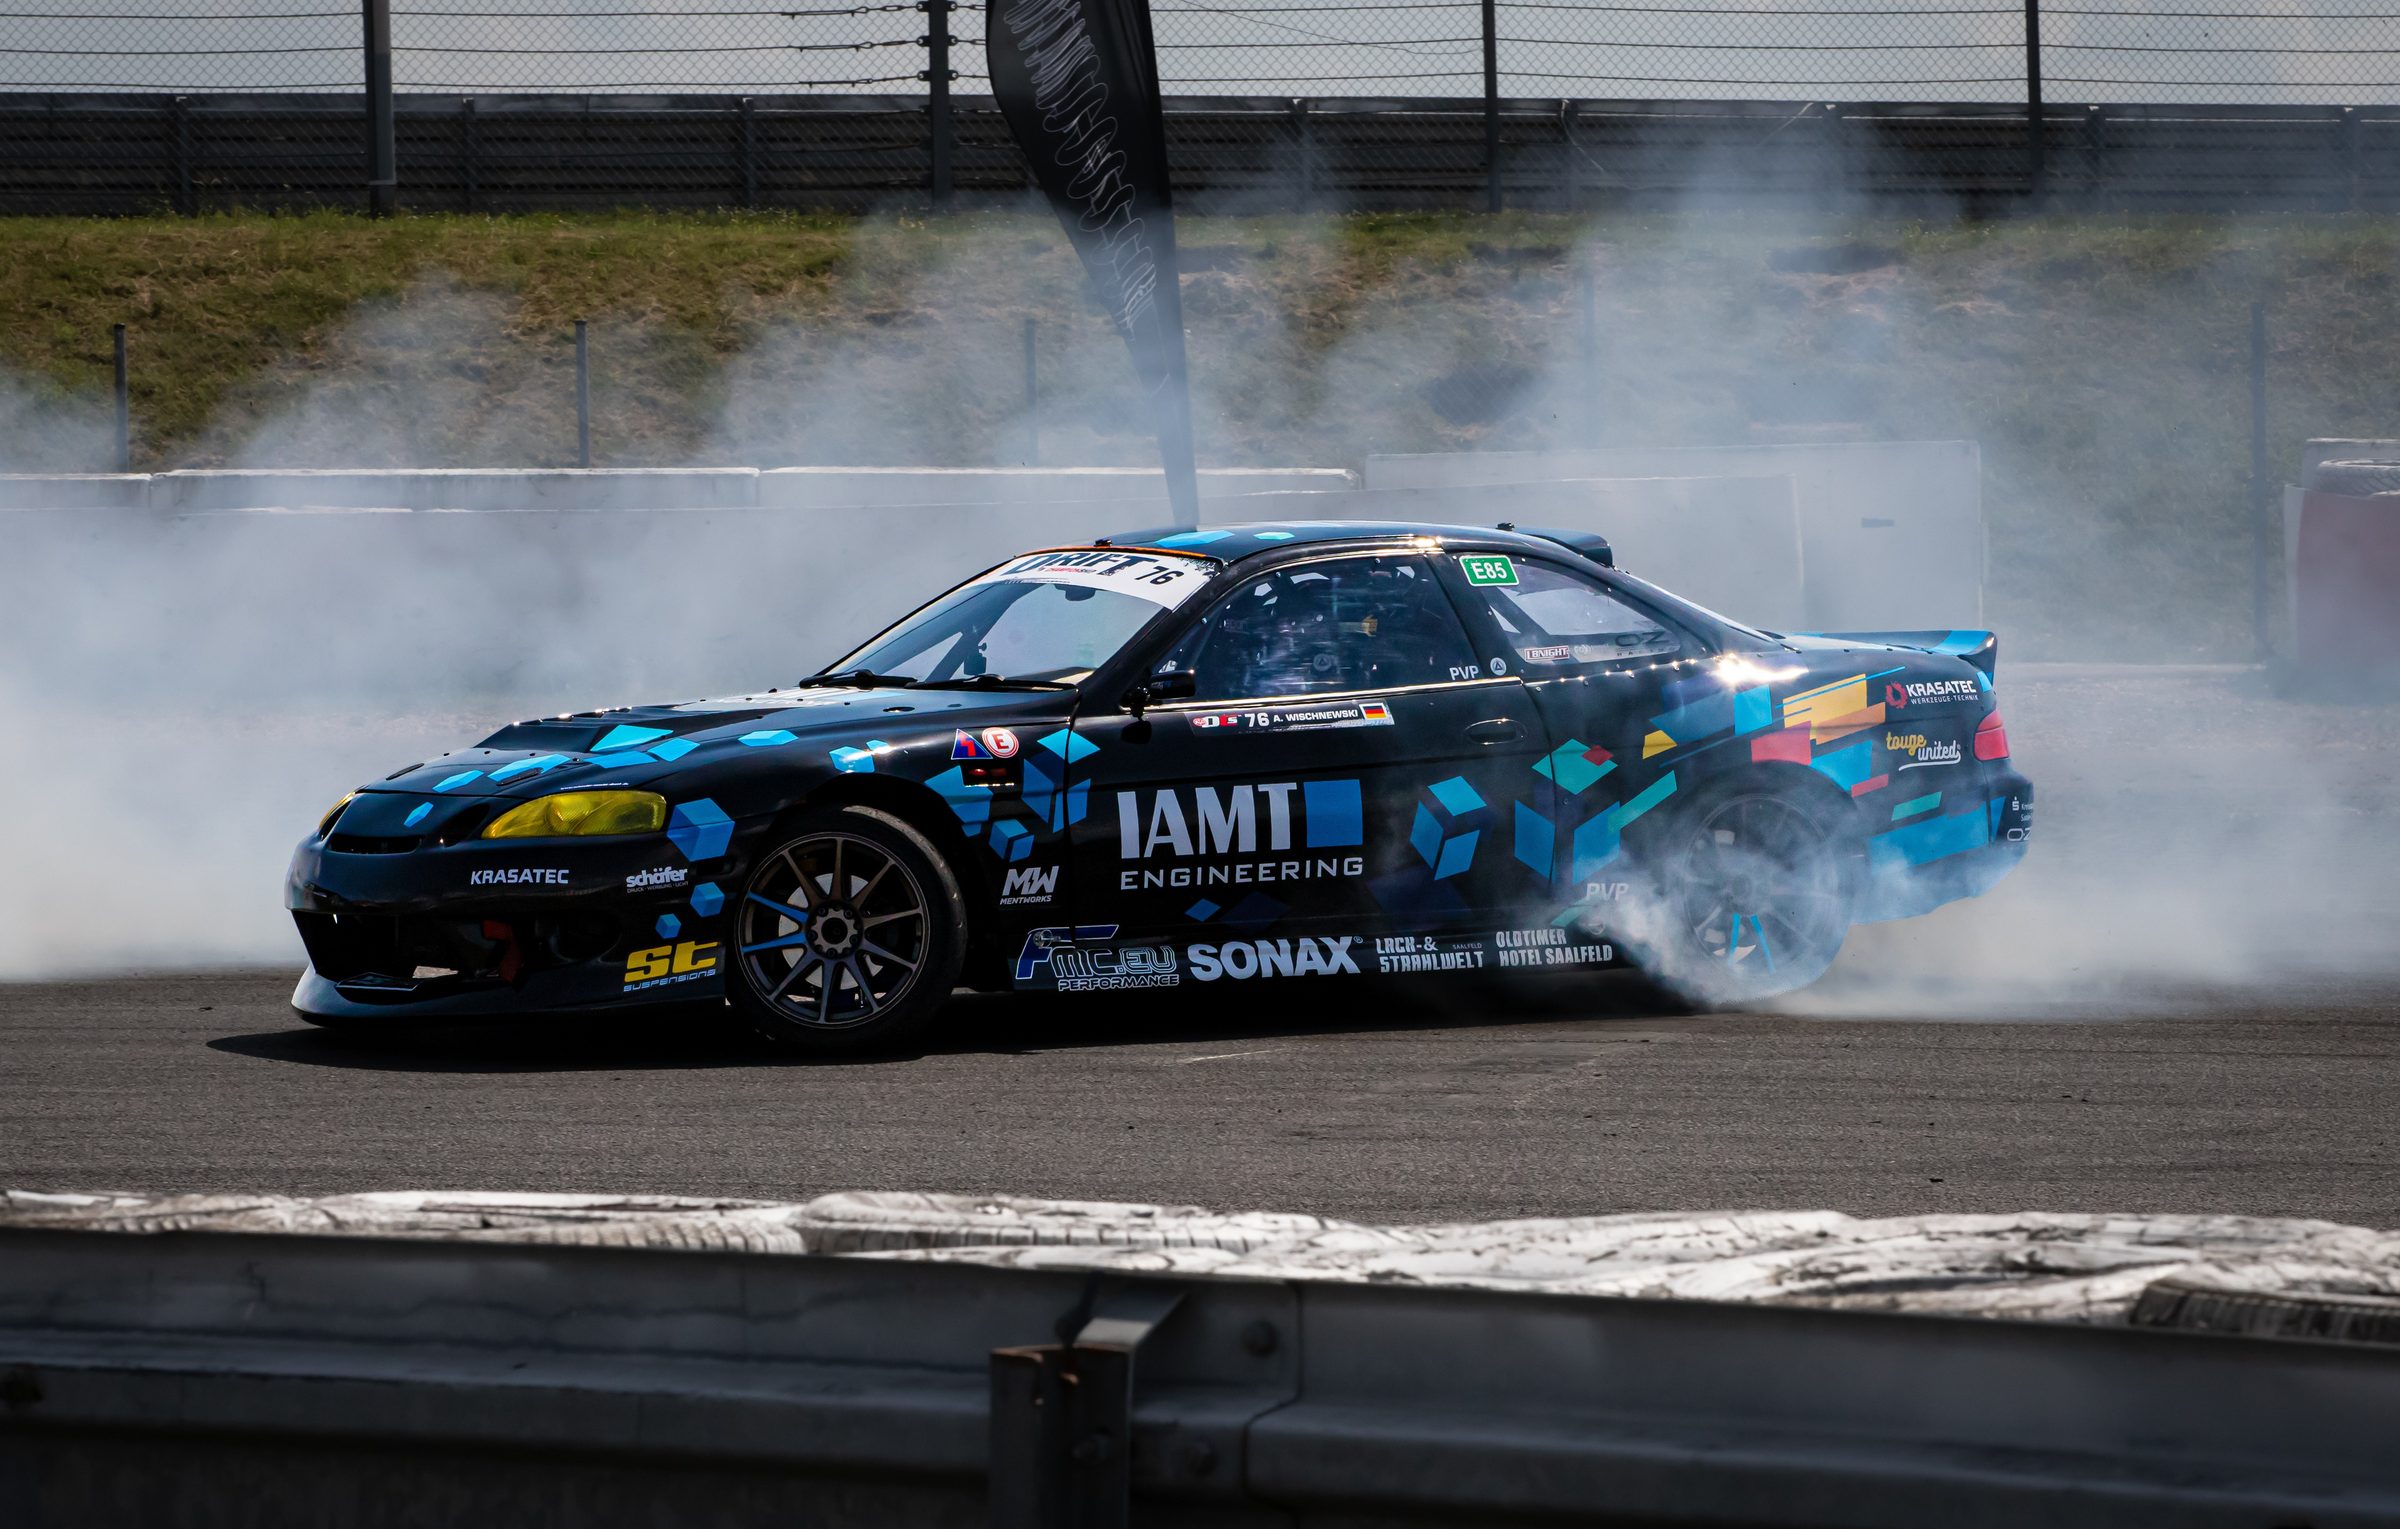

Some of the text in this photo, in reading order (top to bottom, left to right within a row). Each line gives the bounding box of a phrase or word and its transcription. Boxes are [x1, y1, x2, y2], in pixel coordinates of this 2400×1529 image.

[1001, 552, 1158, 576] DRIFT
[1471, 562, 1507, 579] E85
[1134, 565, 1184, 585] 76
[1449, 665, 1480, 681] PVP
[1906, 680, 1977, 697] KRASATEC
[1244, 712, 1270, 728] 76
[1273, 714, 1284, 723] A.
[1286, 709, 1359, 722] WISCHNEWSKI
[993, 733, 1010, 750] E
[1886, 731, 1927, 756] touge
[1117, 782, 1298, 860] IAMT
[471, 868, 570, 885] KRASATEC
[626, 866, 688, 888] schäfer
[1002, 865, 1060, 896] MW
[1120, 857, 1364, 891] ENGINEERING
[1000, 894, 1053, 905] MENTWORKS
[1586, 882, 1629, 901] PVP
[1423, 936, 1439, 952] &
[1452, 943, 1483, 951] SAALFELD
[1495, 929, 1567, 948] OLDTIMER
[1379, 951, 1484, 973] STRAHLWELT
[1499, 944, 1613, 967] HOTEL SAALFELD
[623, 969, 716, 992] SUSPENSIONS
[1058, 974, 1180, 992] PERFORMANCE
